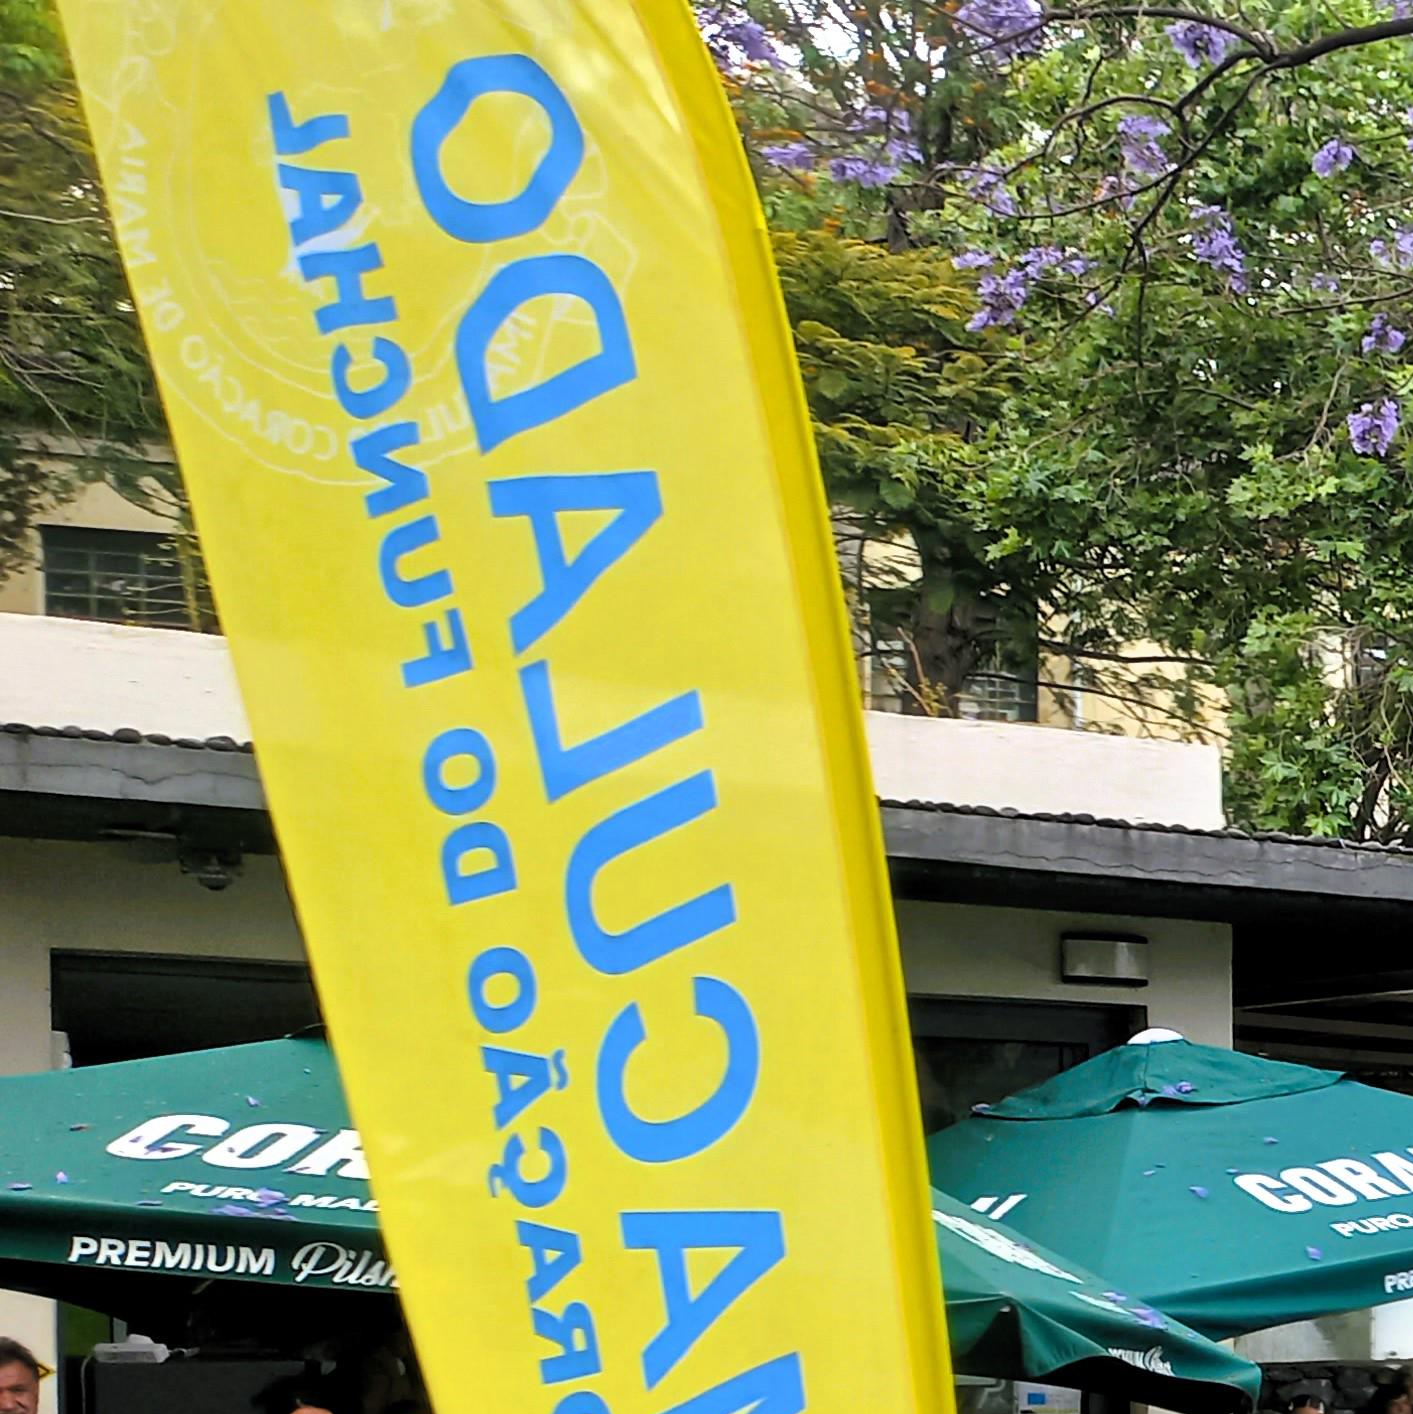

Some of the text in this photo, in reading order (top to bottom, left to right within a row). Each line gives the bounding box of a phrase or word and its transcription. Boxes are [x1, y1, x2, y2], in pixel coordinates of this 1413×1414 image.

[105, 1113, 371, 1181] COR
[288, 1194, 382, 1212] MAL
[67, 1236, 401, 1288] PREMIUM Pilsn
